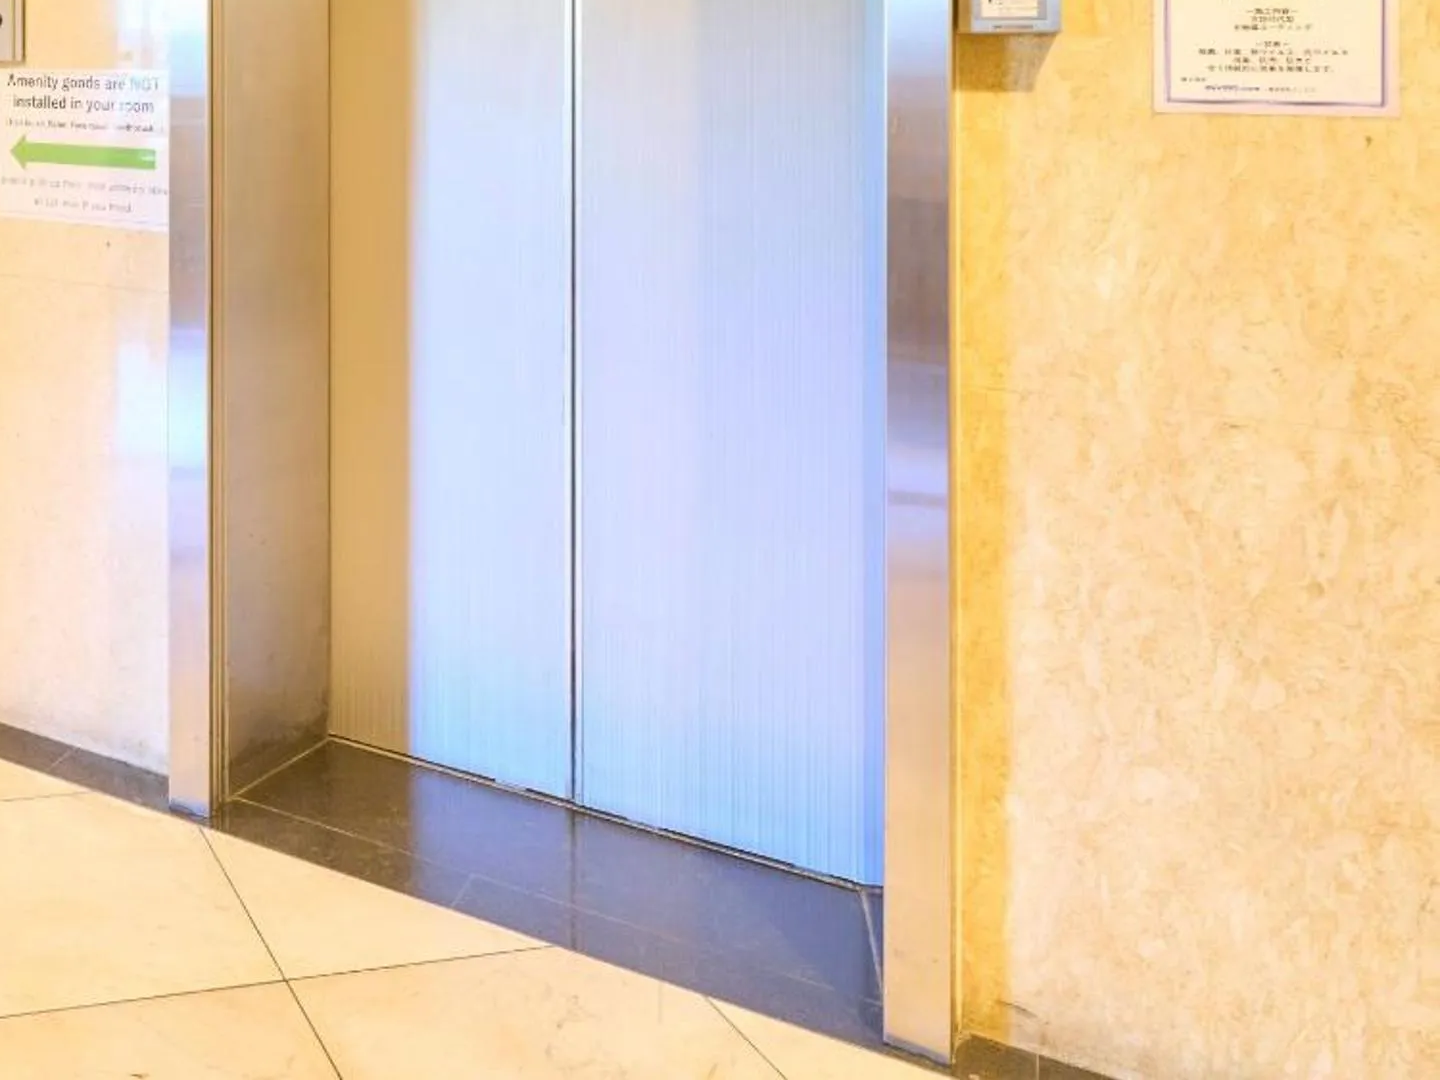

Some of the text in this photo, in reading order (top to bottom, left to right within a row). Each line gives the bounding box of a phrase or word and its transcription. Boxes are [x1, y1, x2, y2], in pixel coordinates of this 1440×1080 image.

[7, 73, 159, 91] Amenity goods are NOT
[13, 94, 154, 113] installed in your room
